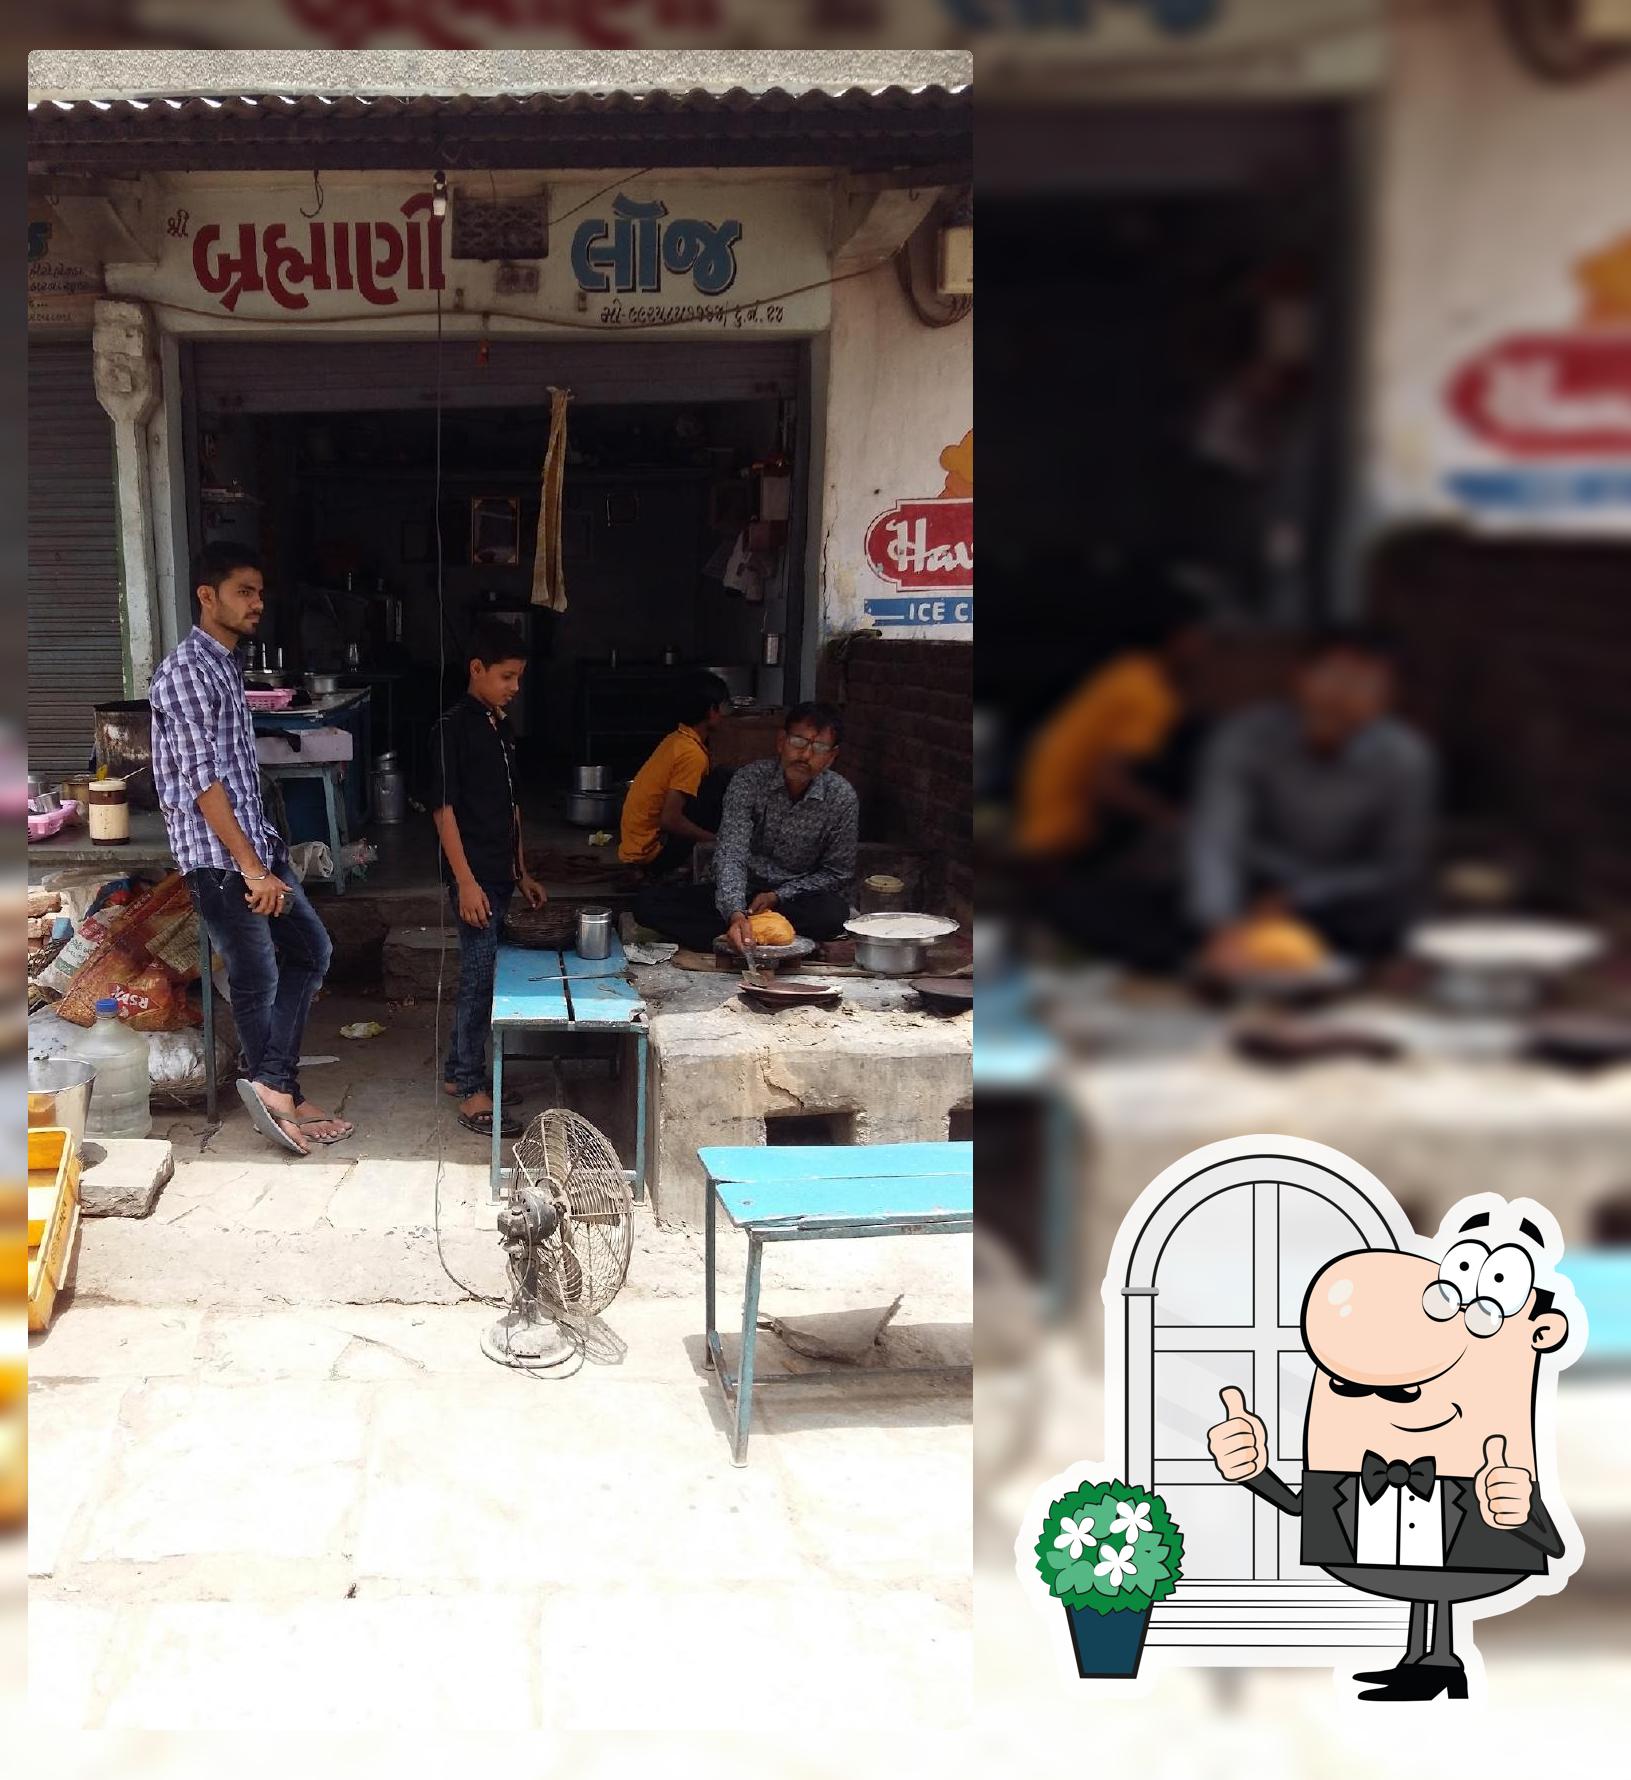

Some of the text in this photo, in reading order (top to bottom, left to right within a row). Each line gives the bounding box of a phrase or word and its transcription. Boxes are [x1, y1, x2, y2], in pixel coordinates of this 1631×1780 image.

[167, 209, 189, 238] શ્રી
[908, 602, 973, 622] ICE C
